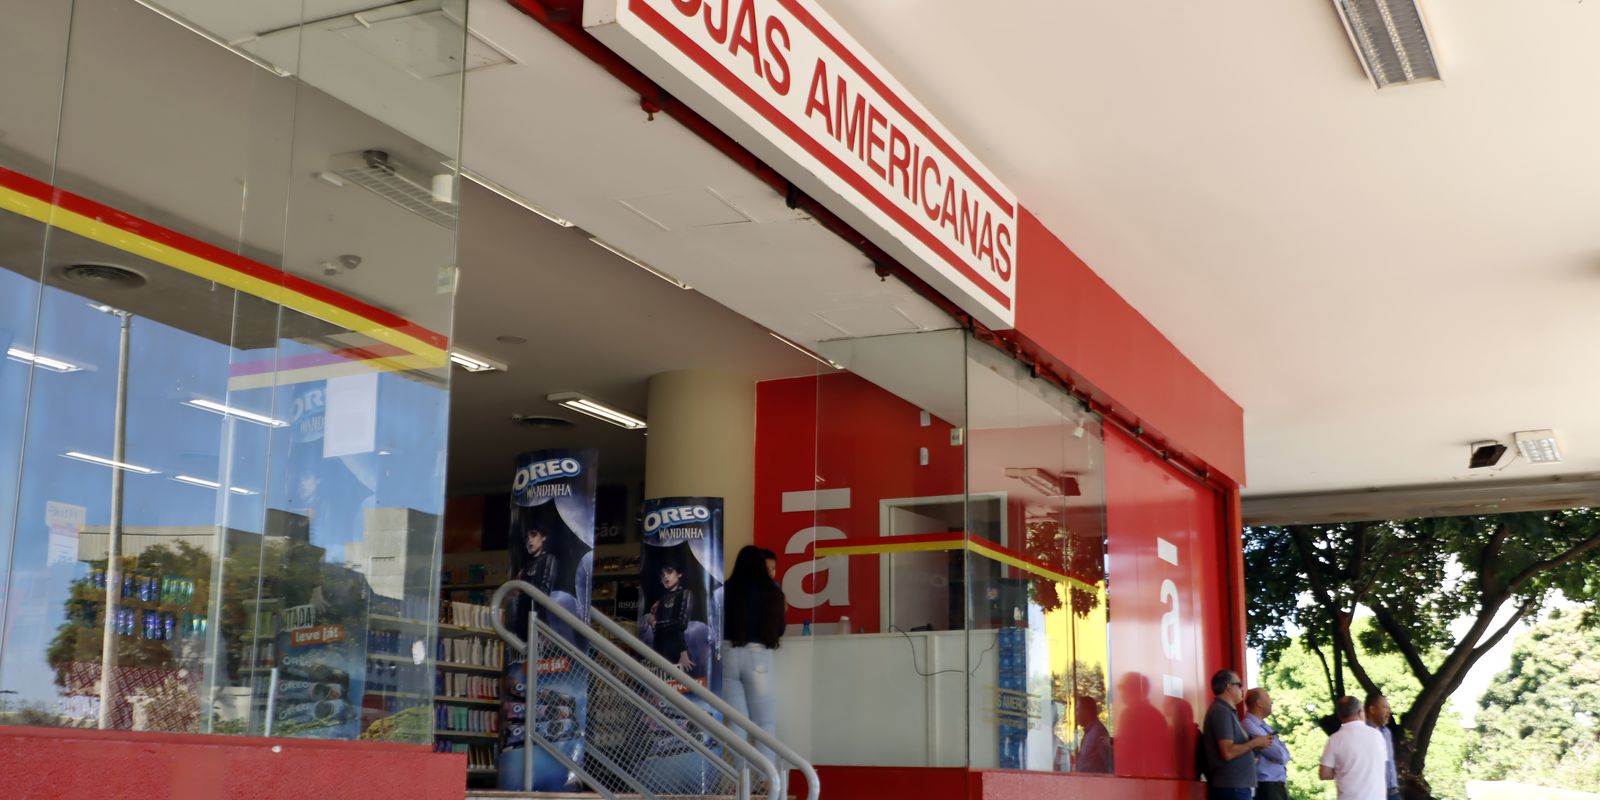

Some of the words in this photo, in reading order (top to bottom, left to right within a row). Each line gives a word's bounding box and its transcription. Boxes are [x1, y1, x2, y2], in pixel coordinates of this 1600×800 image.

[671, 0, 791, 96] JAS
[805, 57, 1011, 282] AMERICANAS
[513, 458, 580, 492] OREO
[526, 483, 572, 499] WANDINHA
[643, 506, 710, 533] OREO
[658, 527, 705, 541] WANDINHA
[295, 631, 320, 643] leve
